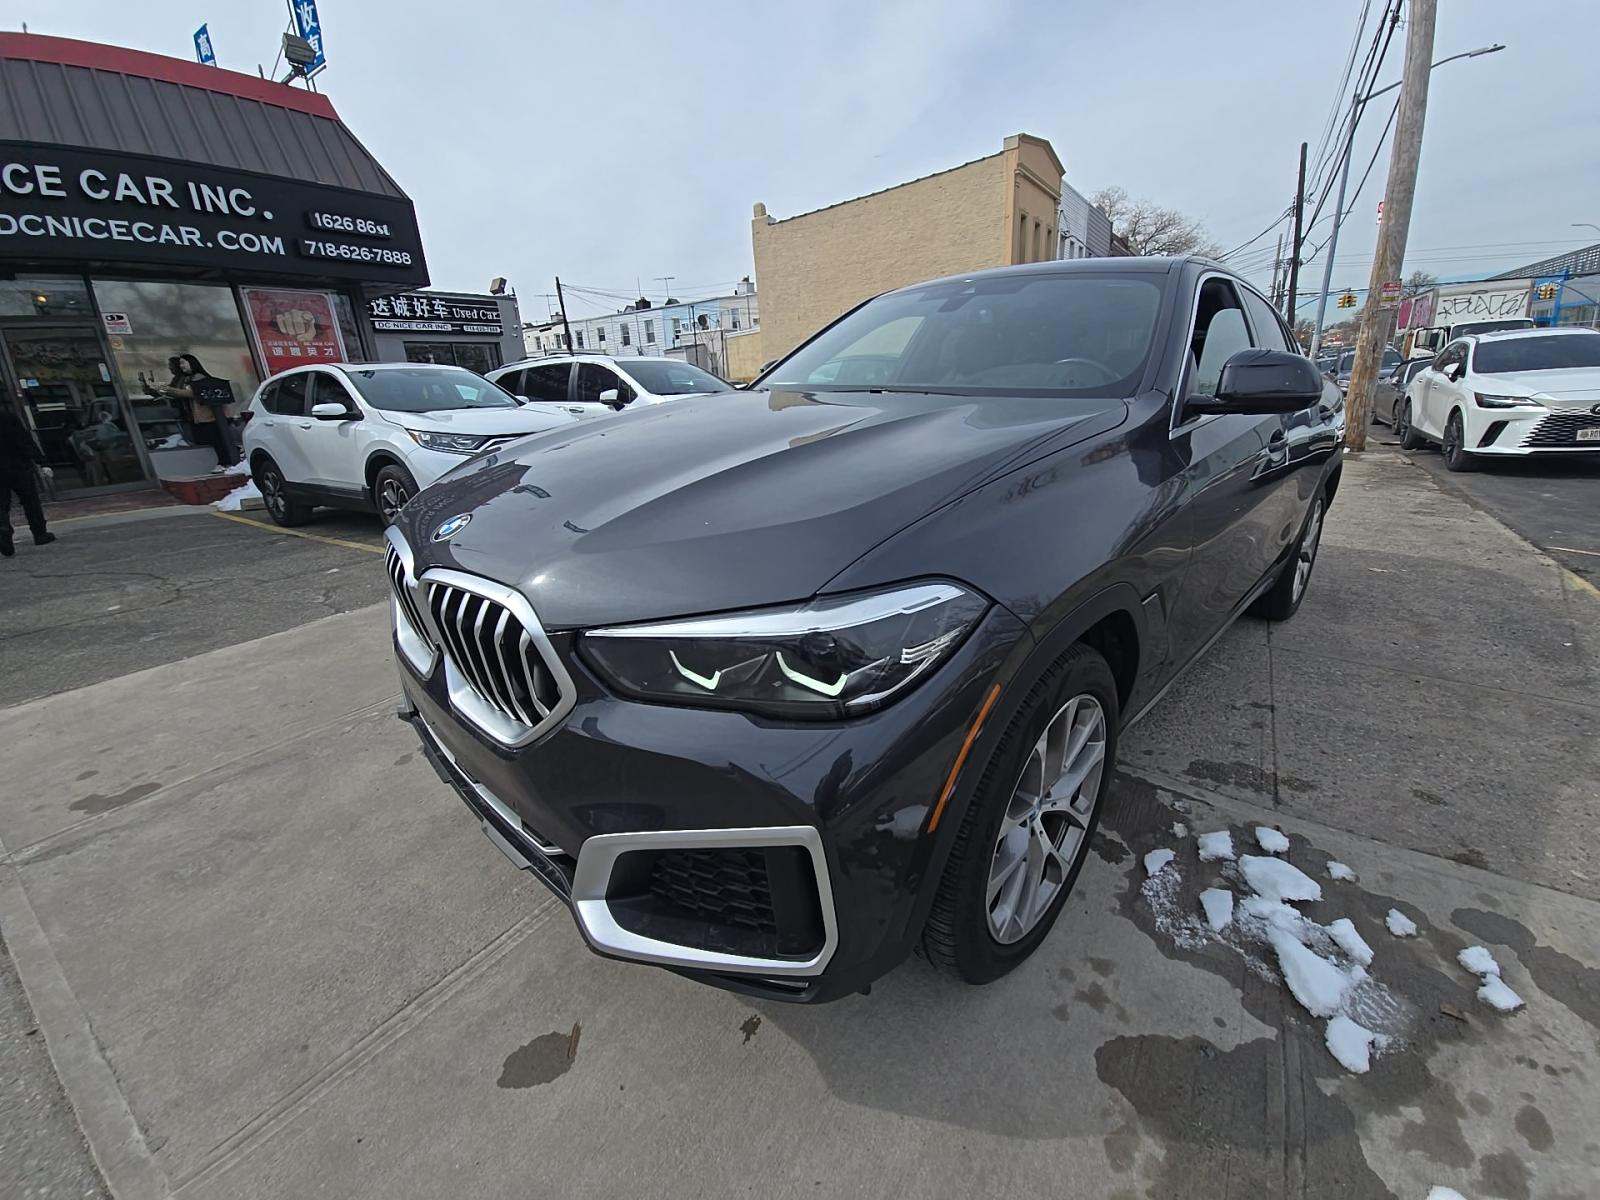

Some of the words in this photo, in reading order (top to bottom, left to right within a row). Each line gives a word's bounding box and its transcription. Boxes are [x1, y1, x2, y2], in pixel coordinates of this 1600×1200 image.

[0, 163, 67, 197] CE
[80, 169, 180, 208] CAR
[188, 182, 273, 220] INC.
[315, 212, 354, 231] 1626
[304, 240, 412, 265] 718-626-7888
[453, 308, 477, 319] Used
[480, 310, 498, 320] Car
